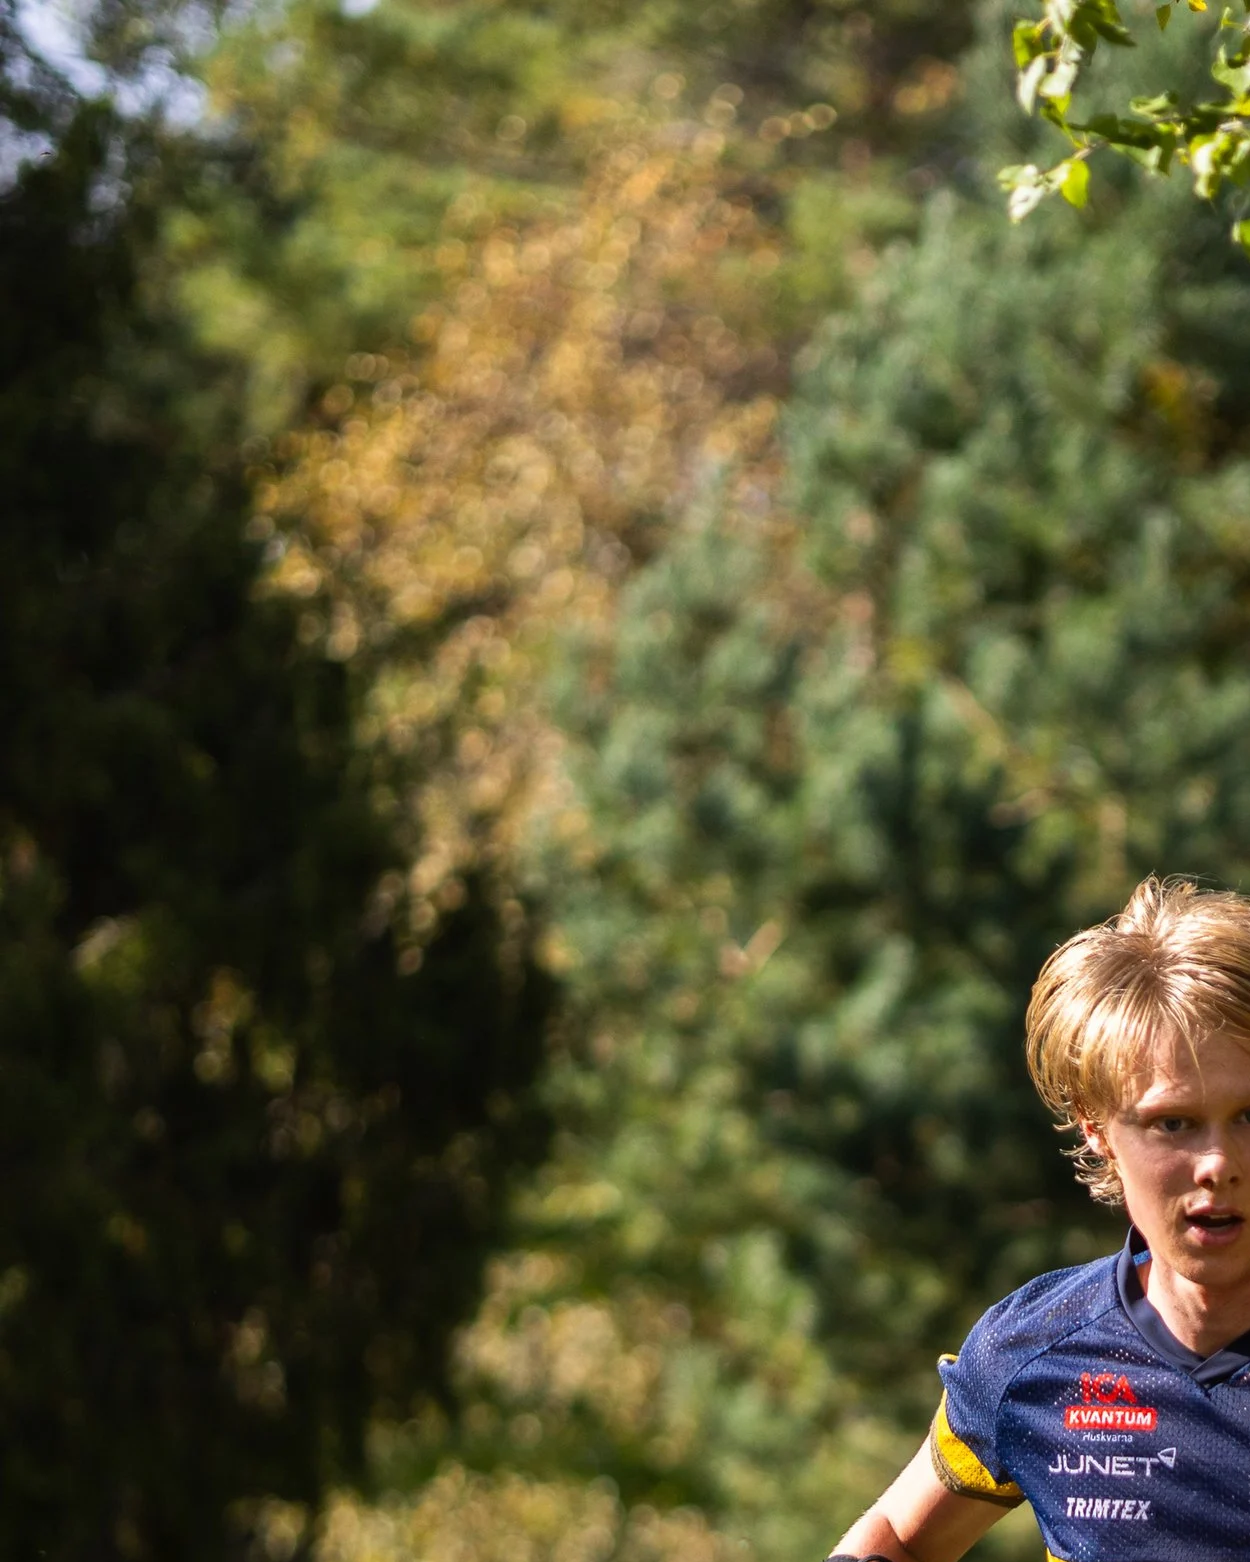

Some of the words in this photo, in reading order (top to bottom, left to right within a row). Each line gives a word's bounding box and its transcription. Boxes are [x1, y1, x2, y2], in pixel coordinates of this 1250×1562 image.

[1081, 1372, 1138, 1403] ICA
[1069, 1410, 1152, 1425] KVANTUM
[1082, 1432, 1133, 1443] Huskvarna
[1048, 1453, 1159, 1477] JUNET
[1066, 1497, 1152, 1520] TRIMTEX
